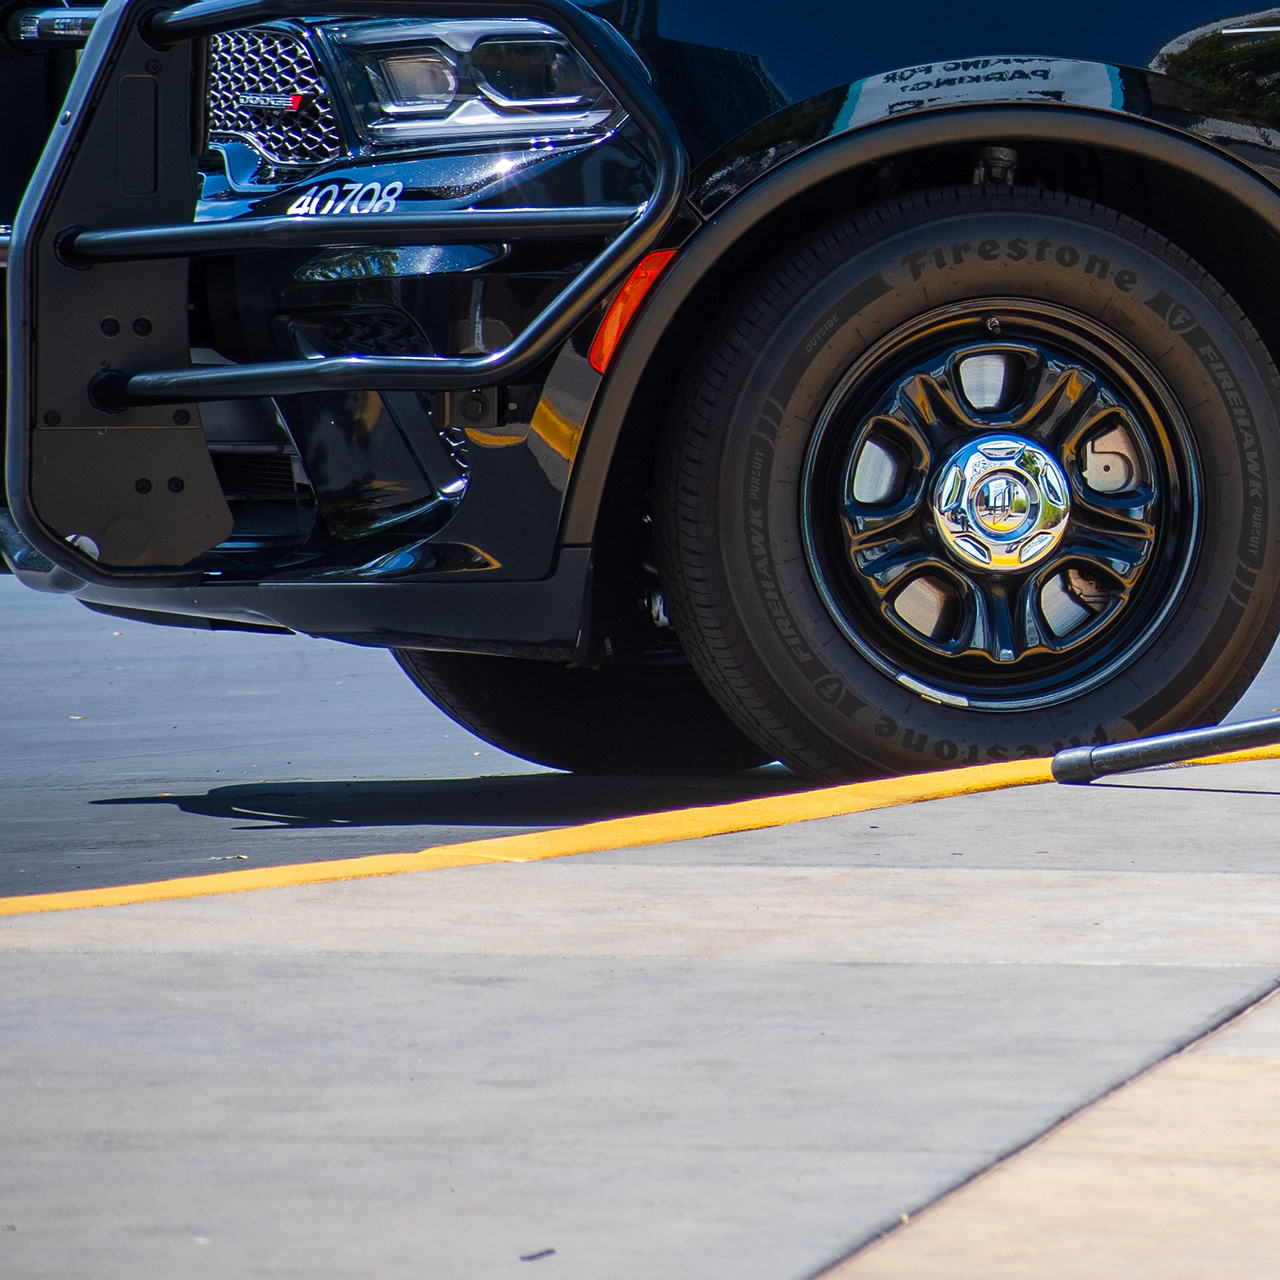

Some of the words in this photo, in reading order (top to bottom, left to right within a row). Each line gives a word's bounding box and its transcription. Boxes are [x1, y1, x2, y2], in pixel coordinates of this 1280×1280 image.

[286, 181, 404, 215] 40708
[901, 236, 1139, 292] Firestone
[805, 313, 841, 354] OUTSIDE
[748, 449, 766, 501] PURSUIT
[1199, 344, 1263, 505] FIREHAWK
[1247, 506, 1263, 557] PURSUIT
[747, 504, 813, 665] FIREHAWK
